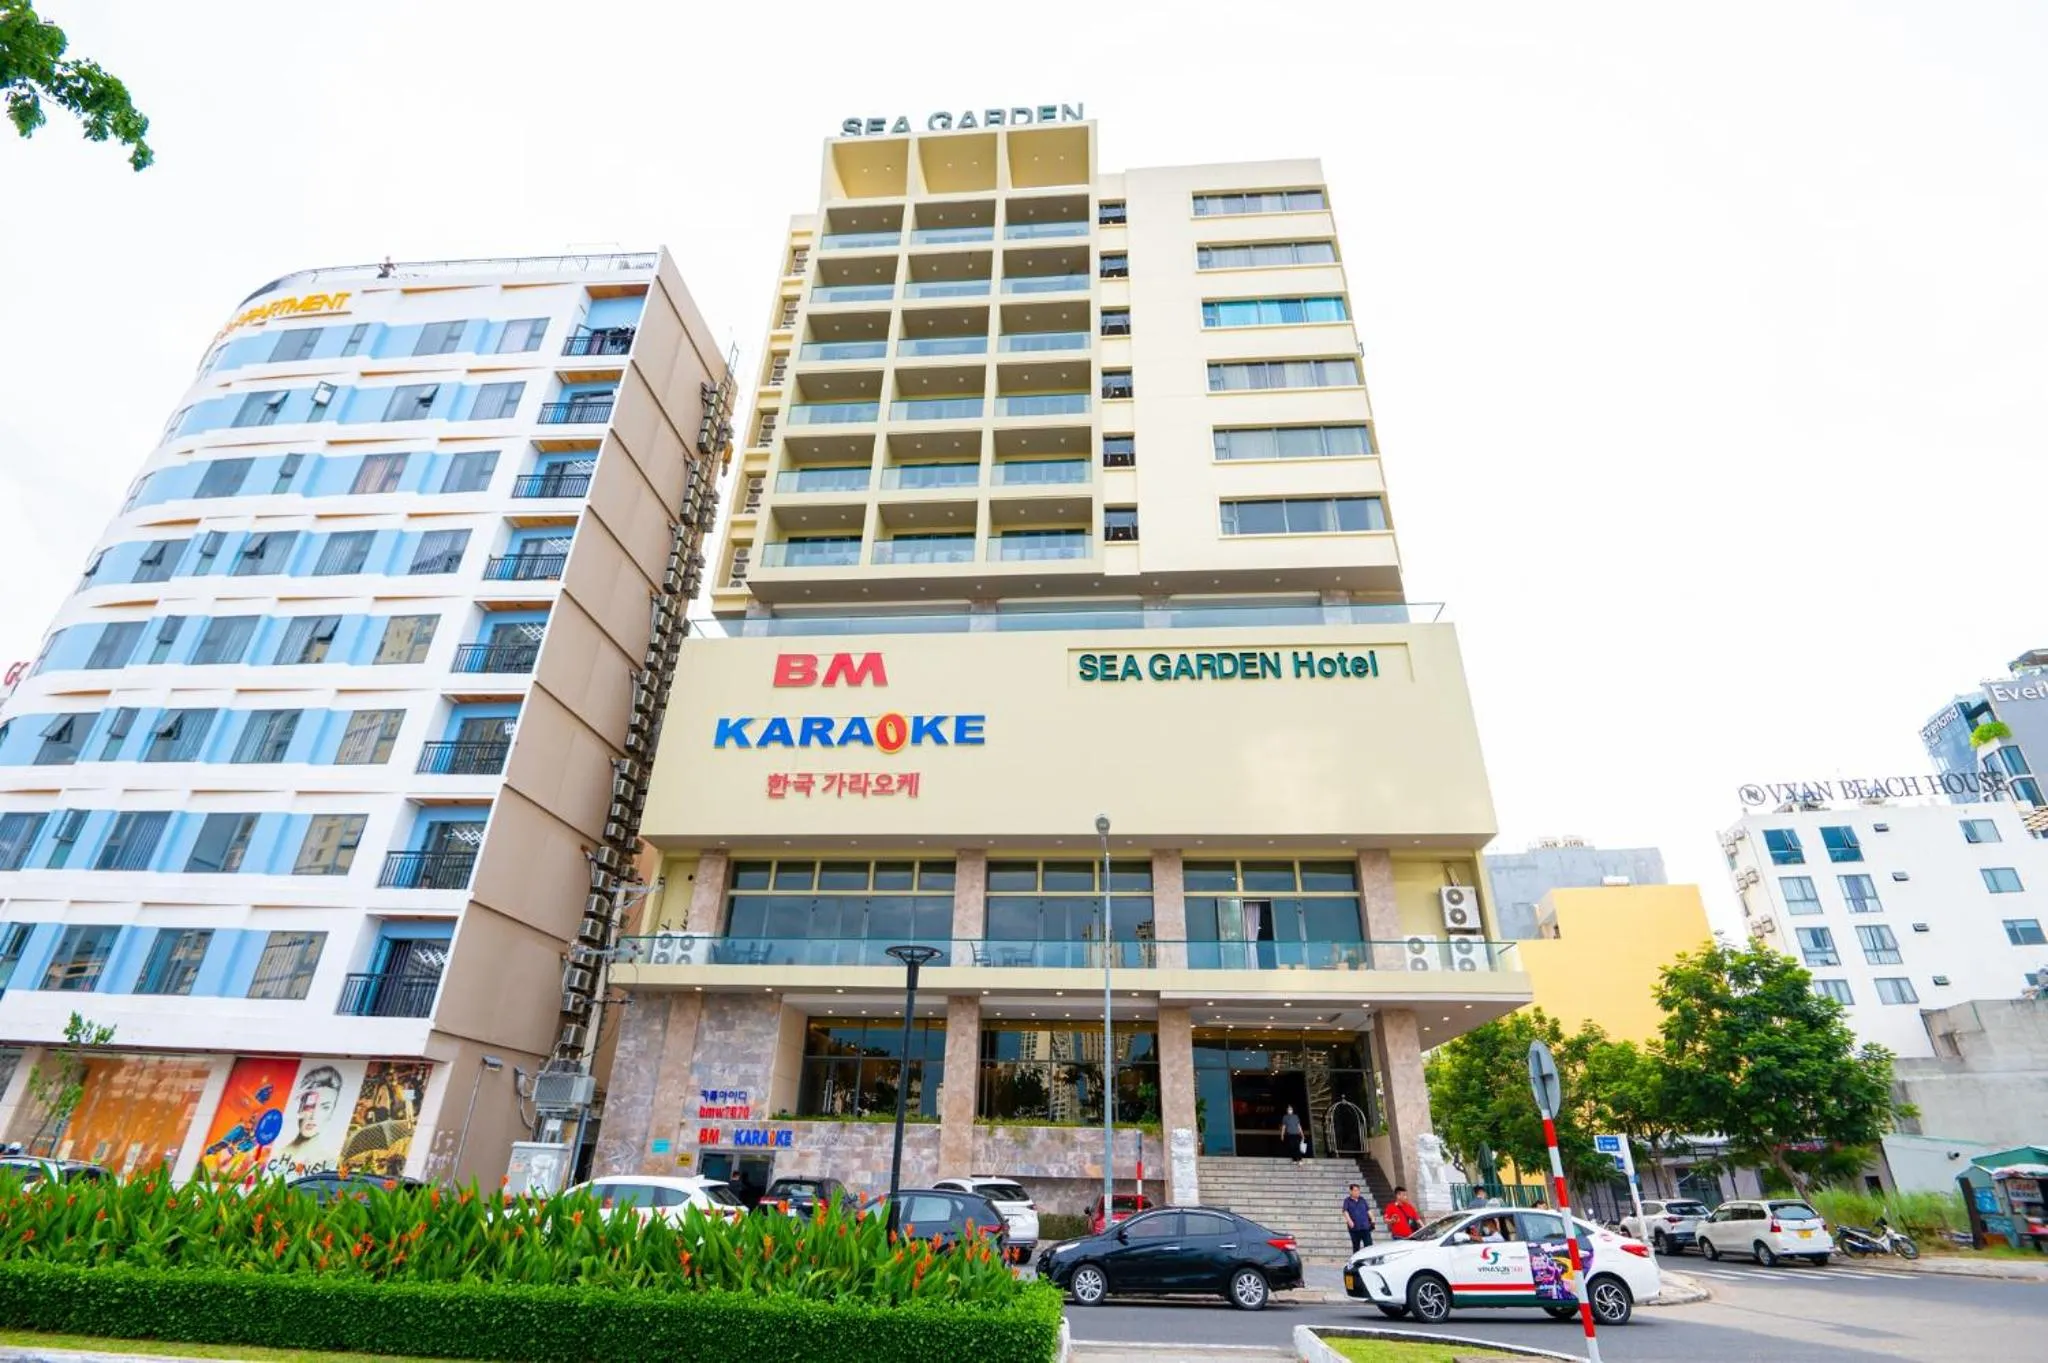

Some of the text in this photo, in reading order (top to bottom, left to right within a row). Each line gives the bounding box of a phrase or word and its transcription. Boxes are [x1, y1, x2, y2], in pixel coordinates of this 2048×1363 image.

[840, 102, 1084, 137] SEA GARDEN
[773, 652, 889, 688] BM
[1079, 650, 1379, 682] SEA GARDEN Hotel
[714, 713, 987, 754] KARAOKE
[766, 772, 921, 800] 한국 가라오케
[1838, 775, 1923, 800] BEACH
[699, 1128, 793, 1147] BM KARAOKE
